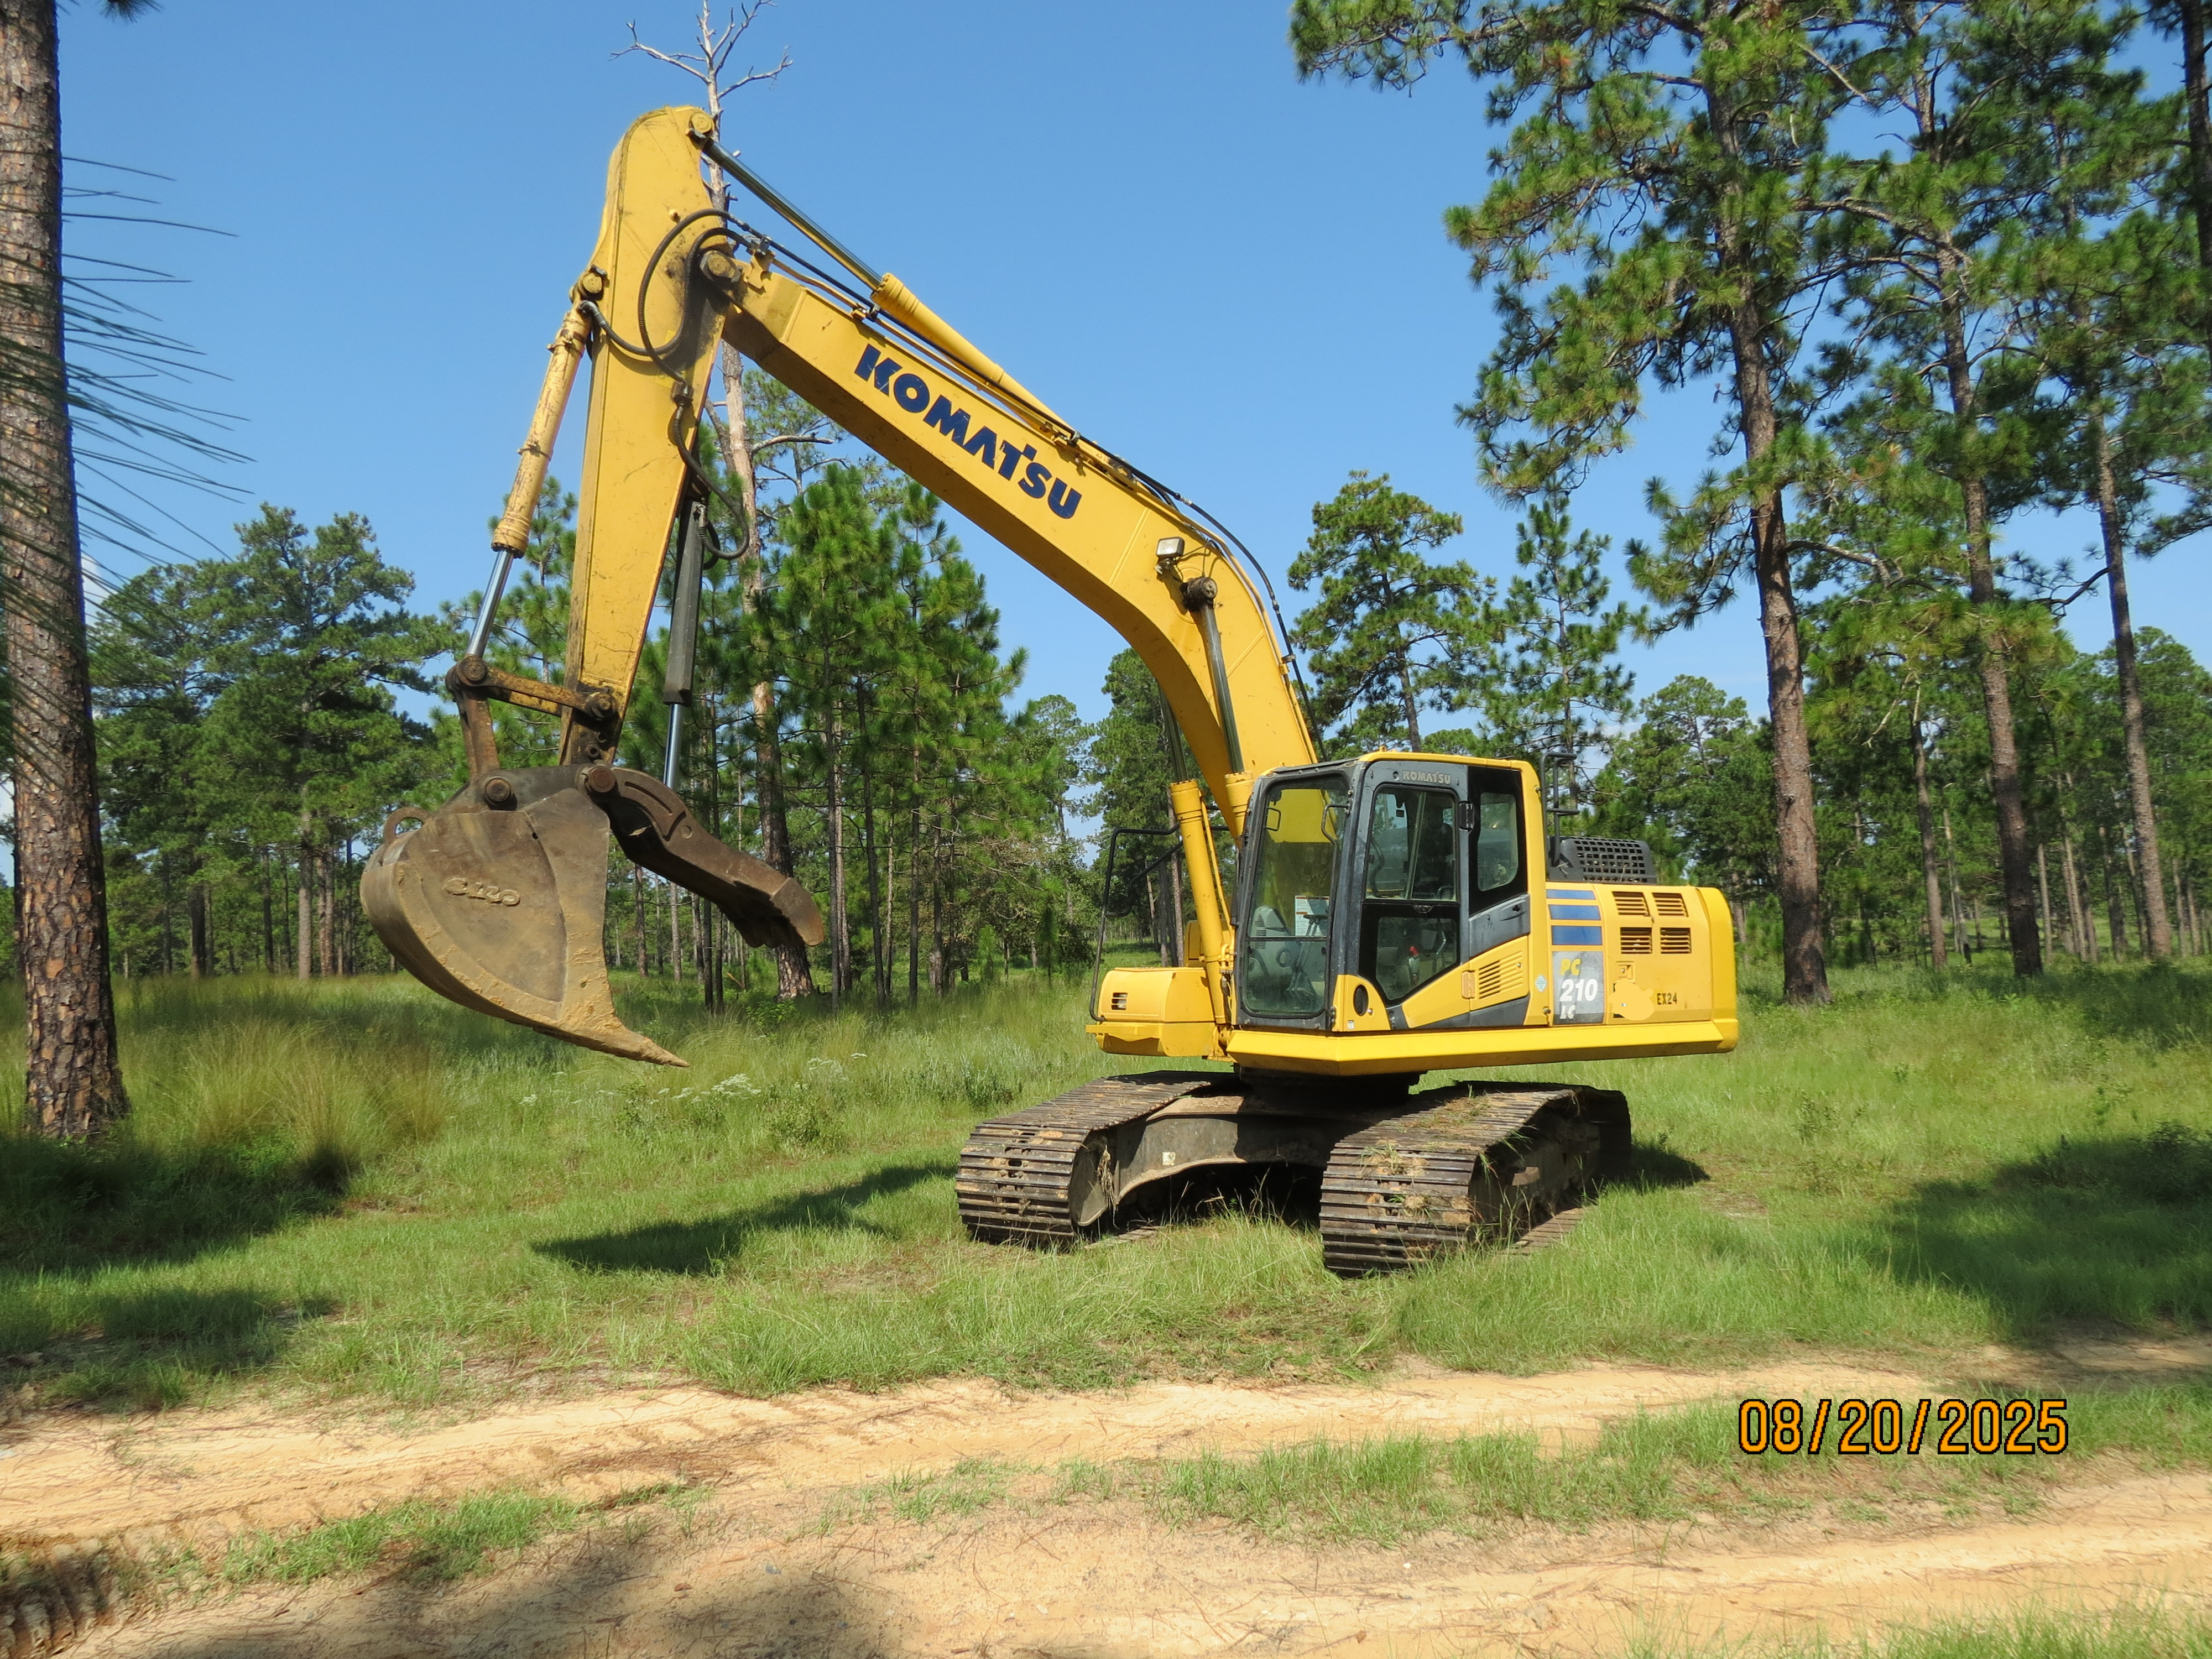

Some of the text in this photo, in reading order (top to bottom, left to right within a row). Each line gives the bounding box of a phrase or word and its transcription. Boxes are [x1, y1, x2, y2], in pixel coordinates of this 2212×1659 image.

[854, 343, 1082, 519] KOMATSU
[1402, 771, 1451, 784] KOMATSU
[1560, 958, 1582, 975] PC
[1559, 979, 1598, 1001] 210
[1657, 993, 1677, 1005] EX24
[1560, 1005, 1576, 1020] LC
